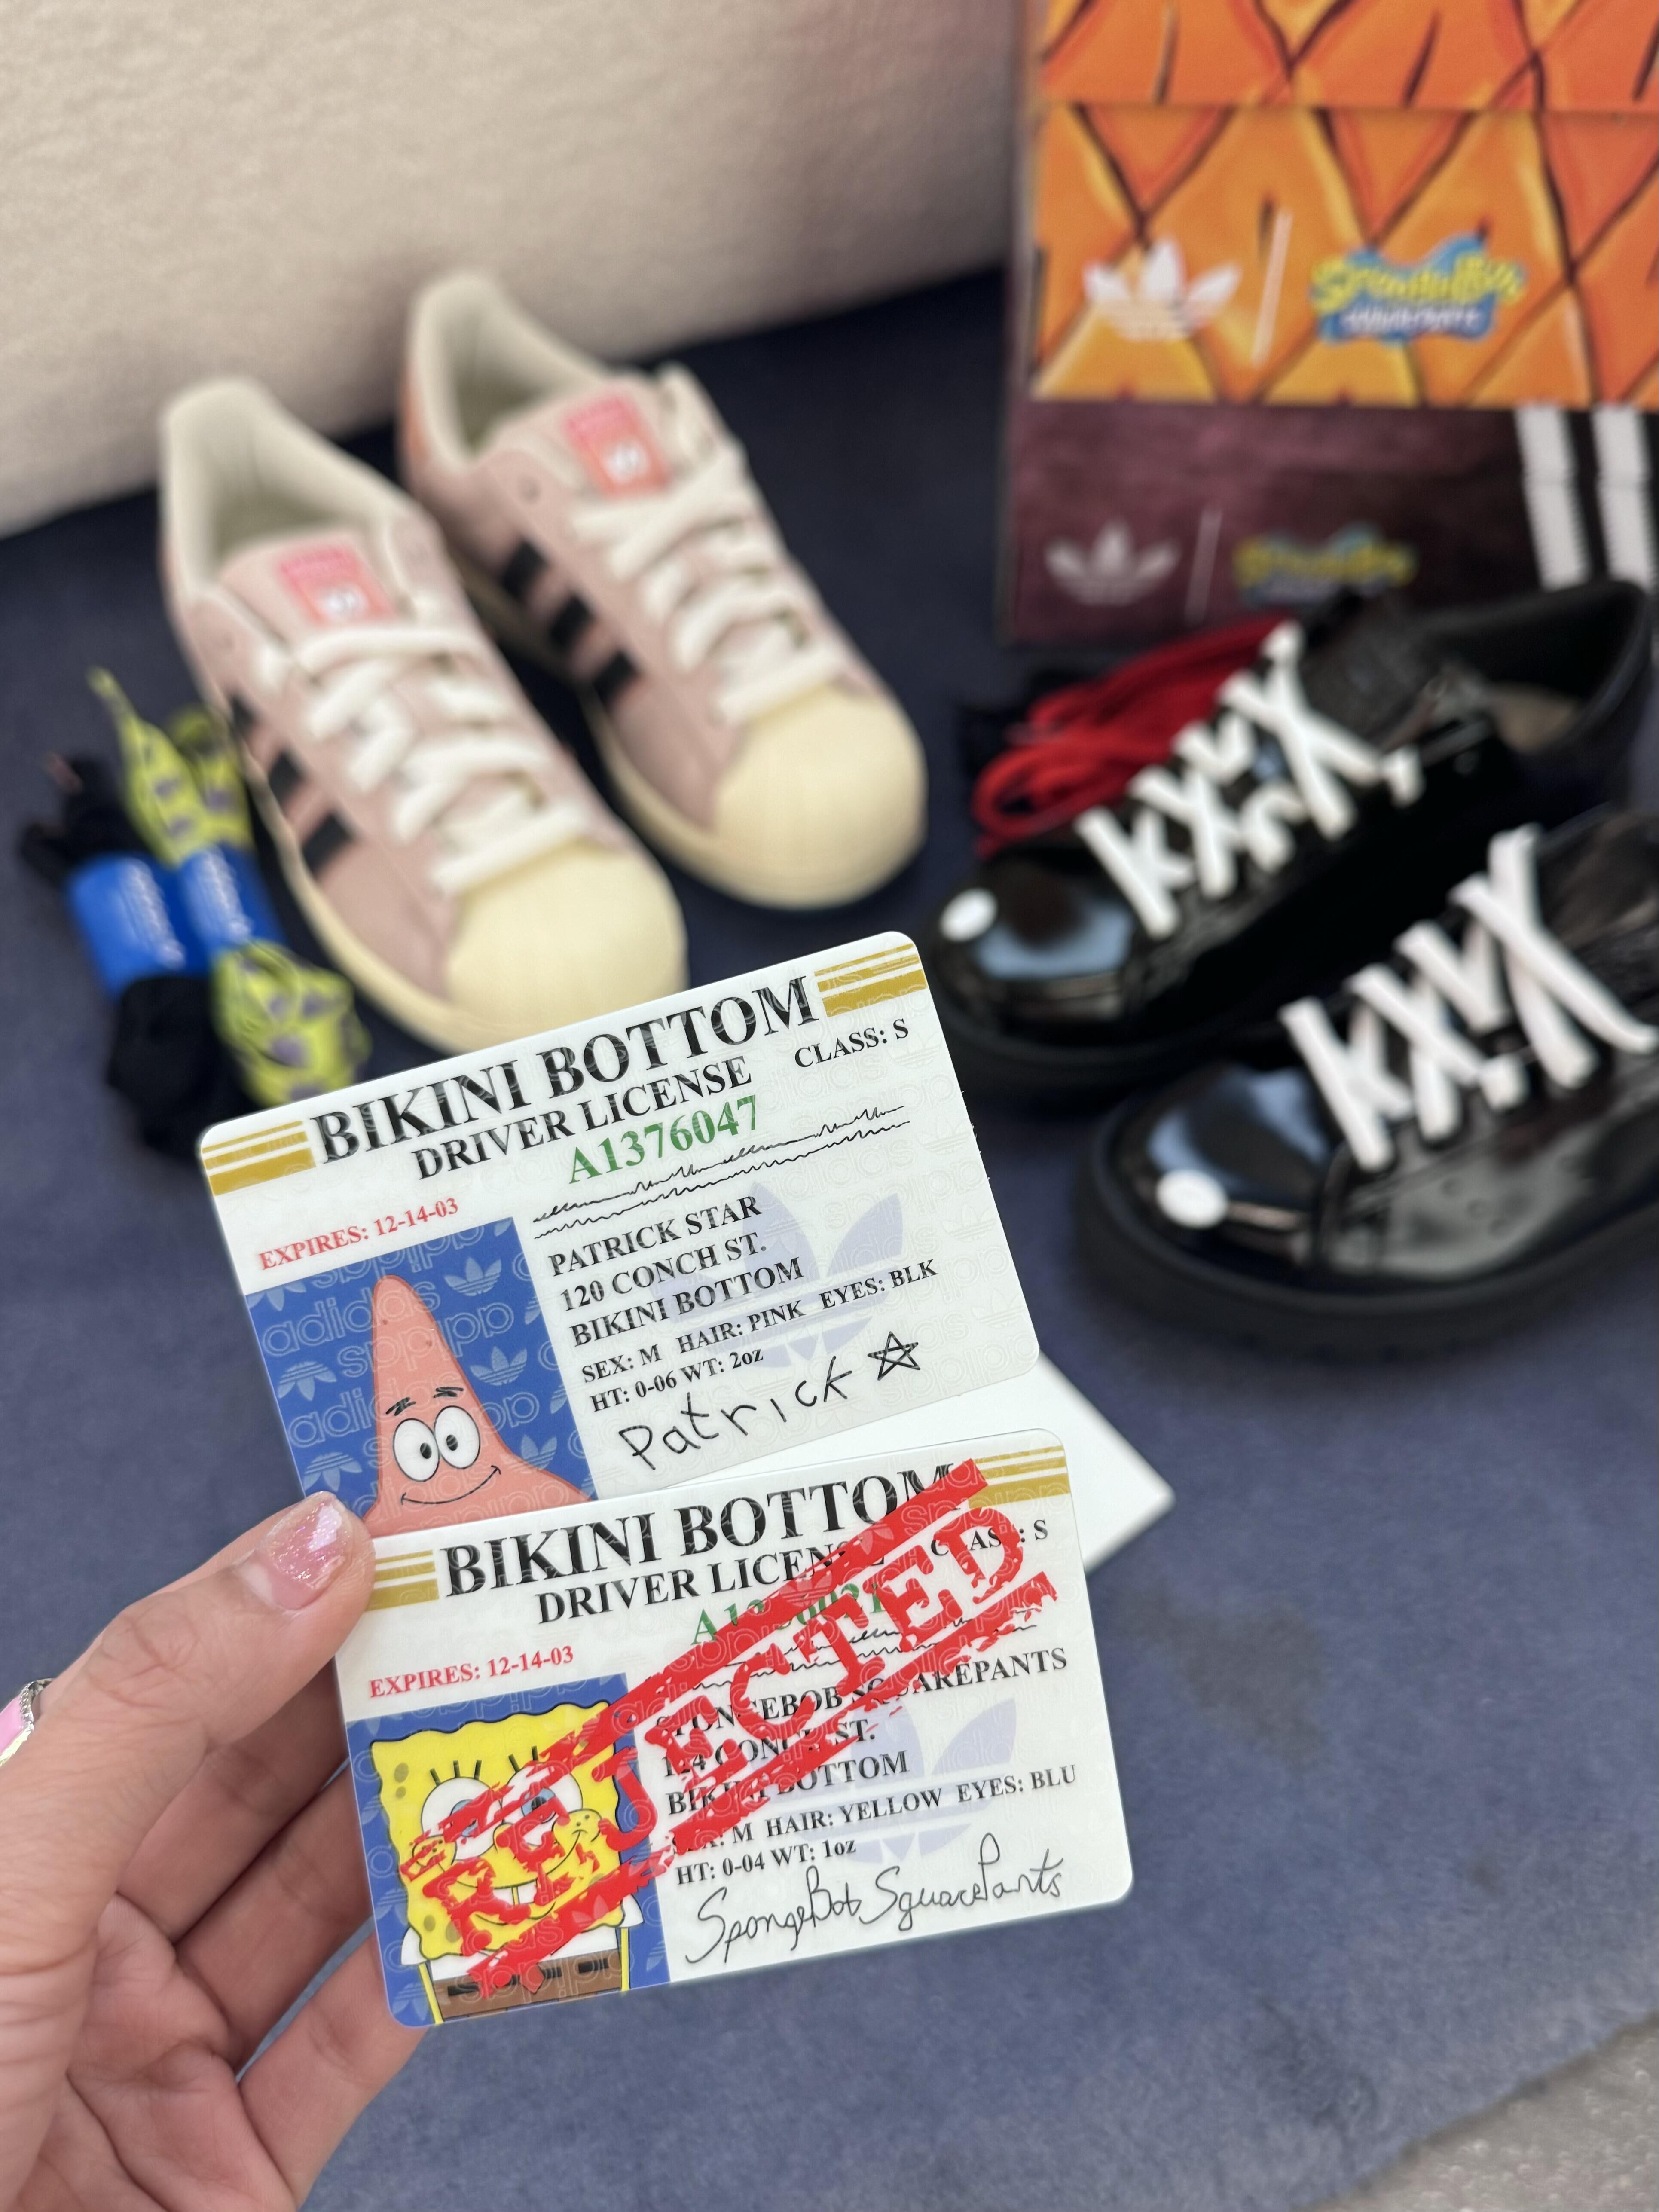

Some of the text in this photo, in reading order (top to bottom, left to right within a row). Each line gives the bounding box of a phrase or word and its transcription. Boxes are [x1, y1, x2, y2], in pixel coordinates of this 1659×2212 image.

[309, 1060, 532, 1164] BIKINI
[535, 975, 819, 1099] BOTTOM
[794, 1018, 908, 1068] CLASS: S
[411, 1110, 576, 1180] DRIVER
[577, 1056, 752, 1131] LICENSE
[570, 1094, 757, 1184] A1376047
[259, 1198, 458, 1269] EXPIRES: 12-14-03
[548, 1196, 763, 1277] PATRICK STAR
[560, 1232, 766, 1311] 120 CONCH ST.
[569, 1256, 804, 1347] BIKINI BOTTOM
[582, 1259, 939, 1383] SEX: M HAIR: PINK EYES: BLK
[589, 1349, 764, 1412] HT: 0-06 WT: 2oz
[618, 1356, 853, 1470] Patrick
[440, 1512, 662, 1597] BIKINI
[1033, 1519, 1048, 1540] S
[535, 1569, 701, 1624] DRIVER
[370, 1645, 574, 1698] EXPIRES: 12-14-03
[422, 1507, 1024, 1957] REJECTED
[733, 1822, 754, 1844] M
[766, 1810, 833, 1837] HAIR:
[838, 1788, 942, 1823] YELLOW
[956, 1775, 1024, 1803] EYES:
[1030, 1765, 1075, 1790] BLU
[776, 1750, 910, 1795] OTTOM
[676, 1840, 856, 1885] HT: 0-04 WT: 1oz
